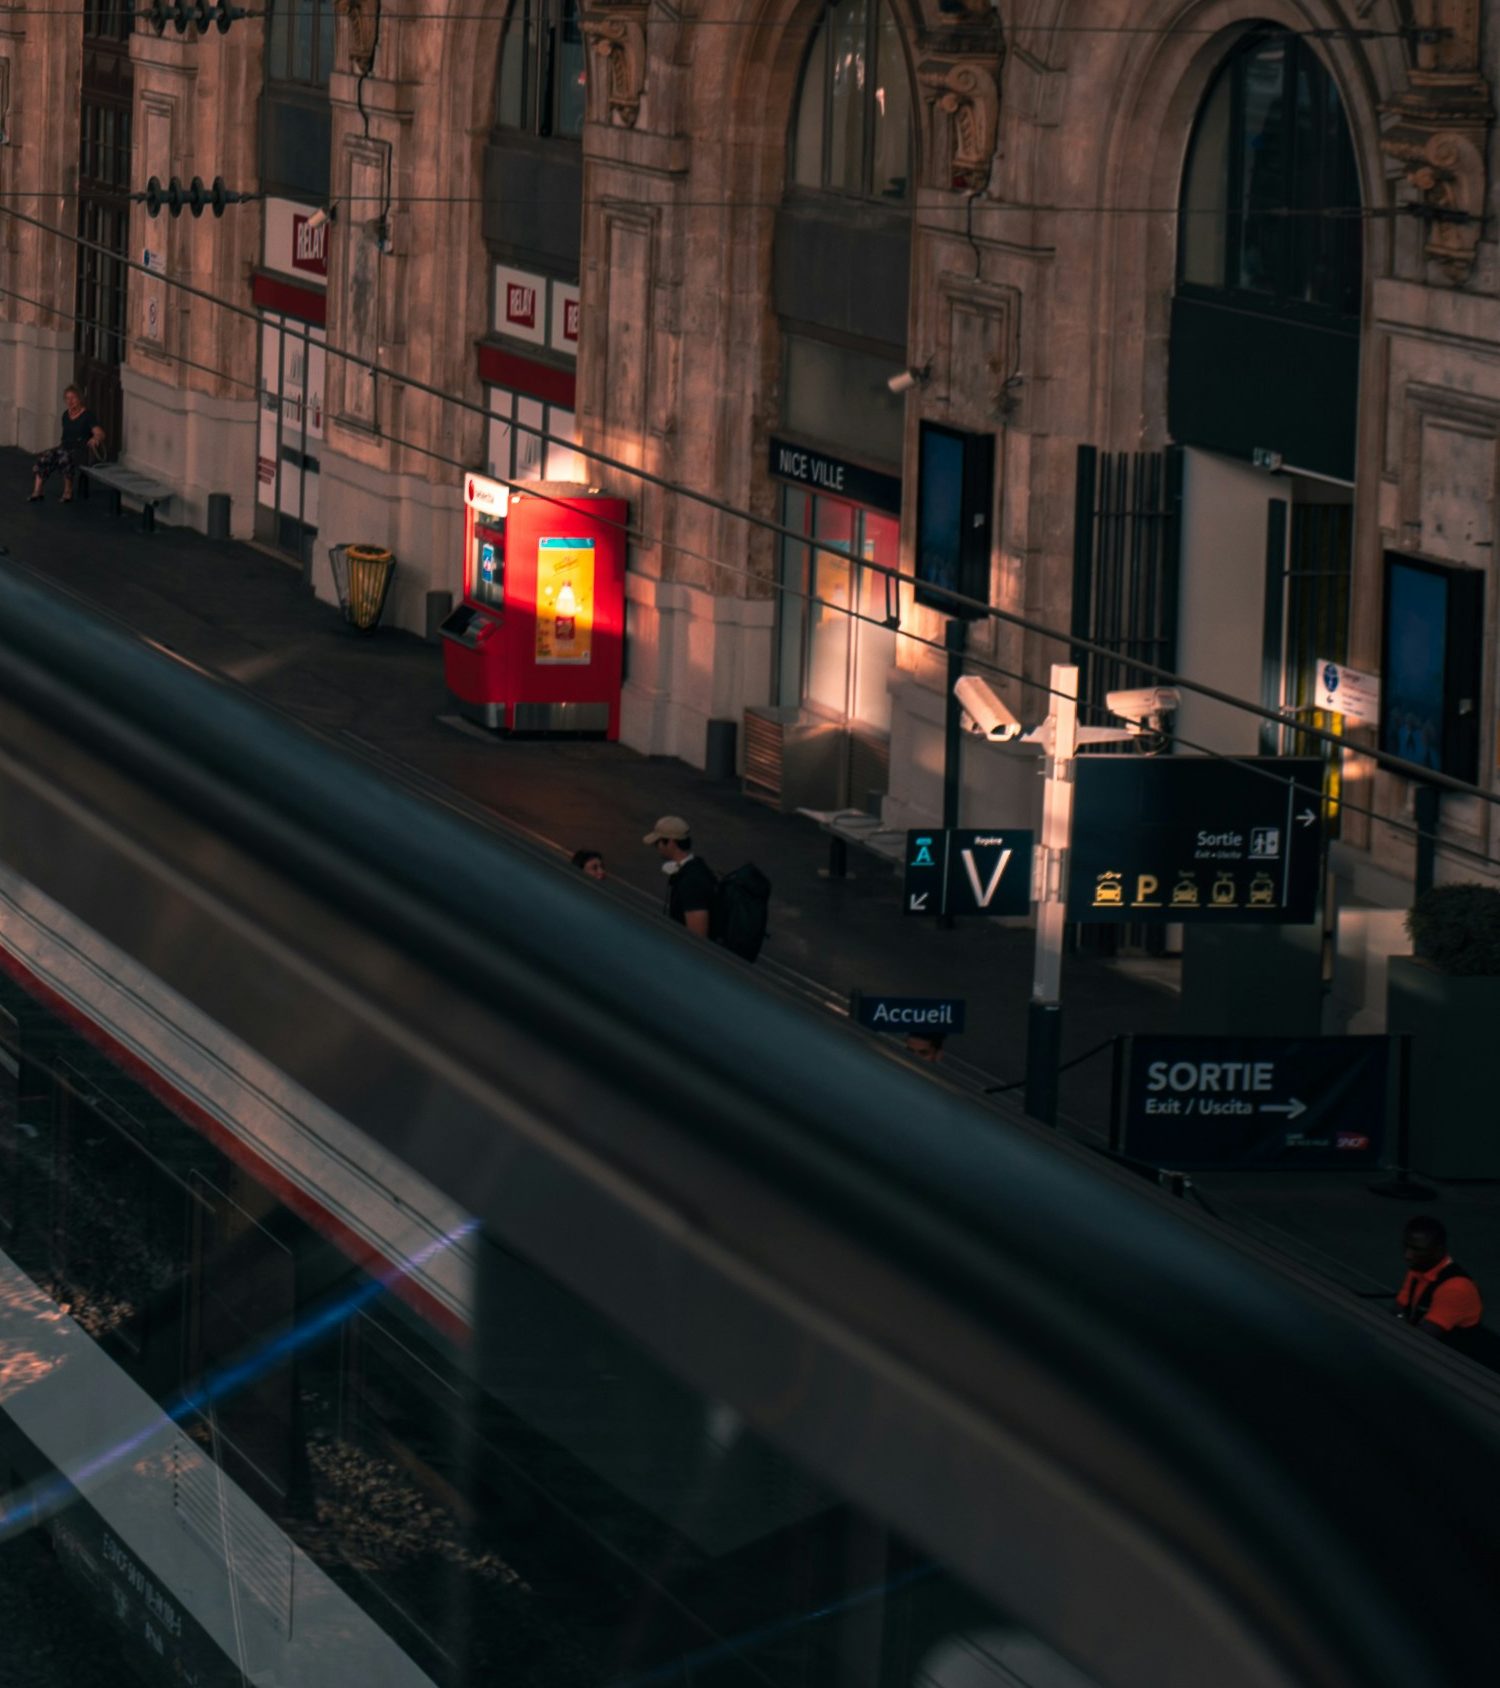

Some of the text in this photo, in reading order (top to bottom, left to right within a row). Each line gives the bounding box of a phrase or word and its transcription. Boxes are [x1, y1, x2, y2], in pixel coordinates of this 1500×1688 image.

[297, 221, 326, 261] RELAY
[510, 288, 532, 316] RELAY
[780, 448, 844, 491] NICE VILLE
[1196, 830, 1243, 847] Sortie
[915, 846, 932, 862] A
[960, 848, 1013, 908] V
[872, 1002, 953, 1024] Accueil
[1146, 1061, 1275, 1092] SORTIE
[1144, 1098, 1182, 1115] Exit
[1198, 1098, 1254, 1115] Uscita
